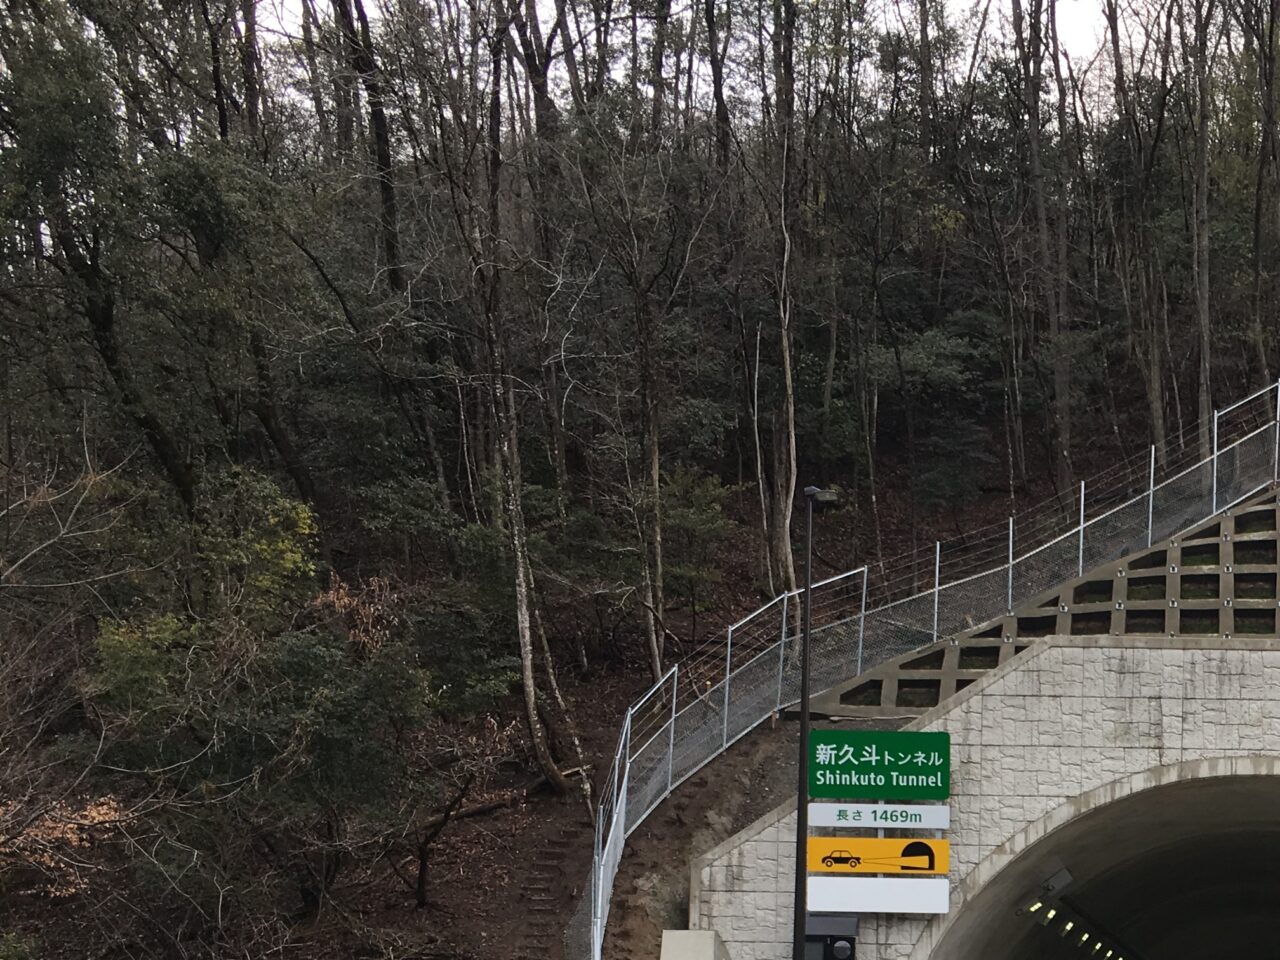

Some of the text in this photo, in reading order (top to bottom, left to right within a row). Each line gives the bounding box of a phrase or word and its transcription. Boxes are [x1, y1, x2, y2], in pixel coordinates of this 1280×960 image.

[816, 744, 943, 767] 新久斗トンネル
[816, 770, 942, 786] Shinkuto Tunnel
[836, 809, 922, 823] 長さ 1469m
